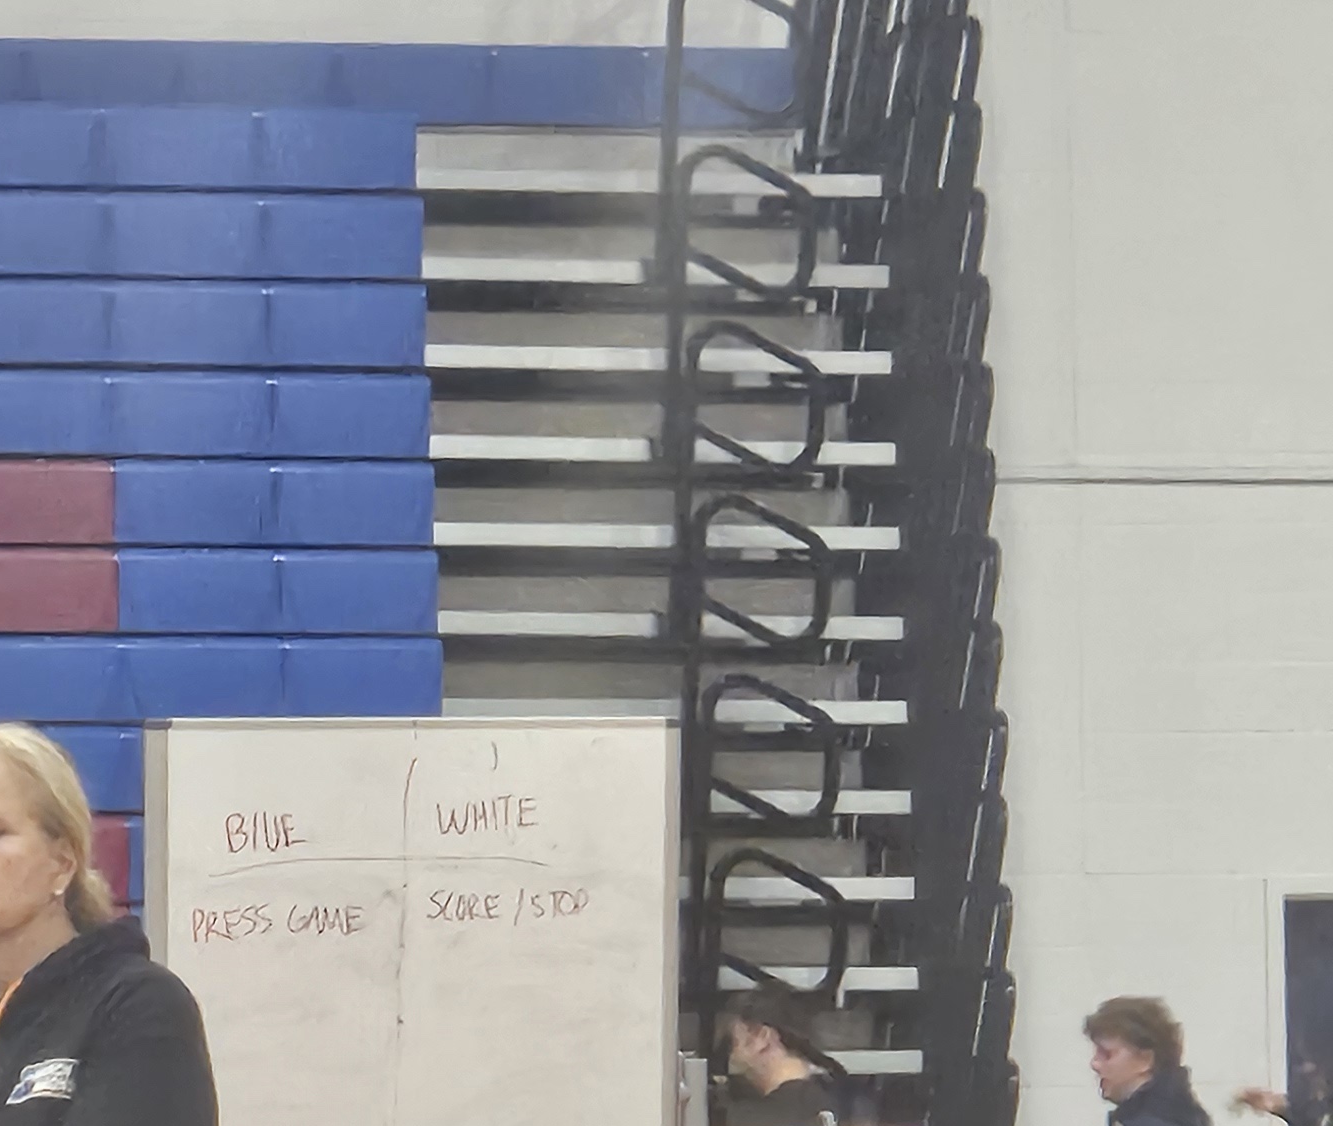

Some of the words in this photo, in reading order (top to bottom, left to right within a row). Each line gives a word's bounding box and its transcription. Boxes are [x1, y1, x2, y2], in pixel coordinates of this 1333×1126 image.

[436, 793, 538, 835] WHITE
[192, 903, 274, 944] PRESS
[286, 903, 366, 936] GAME
[427, 888, 500, 922] SCORE
